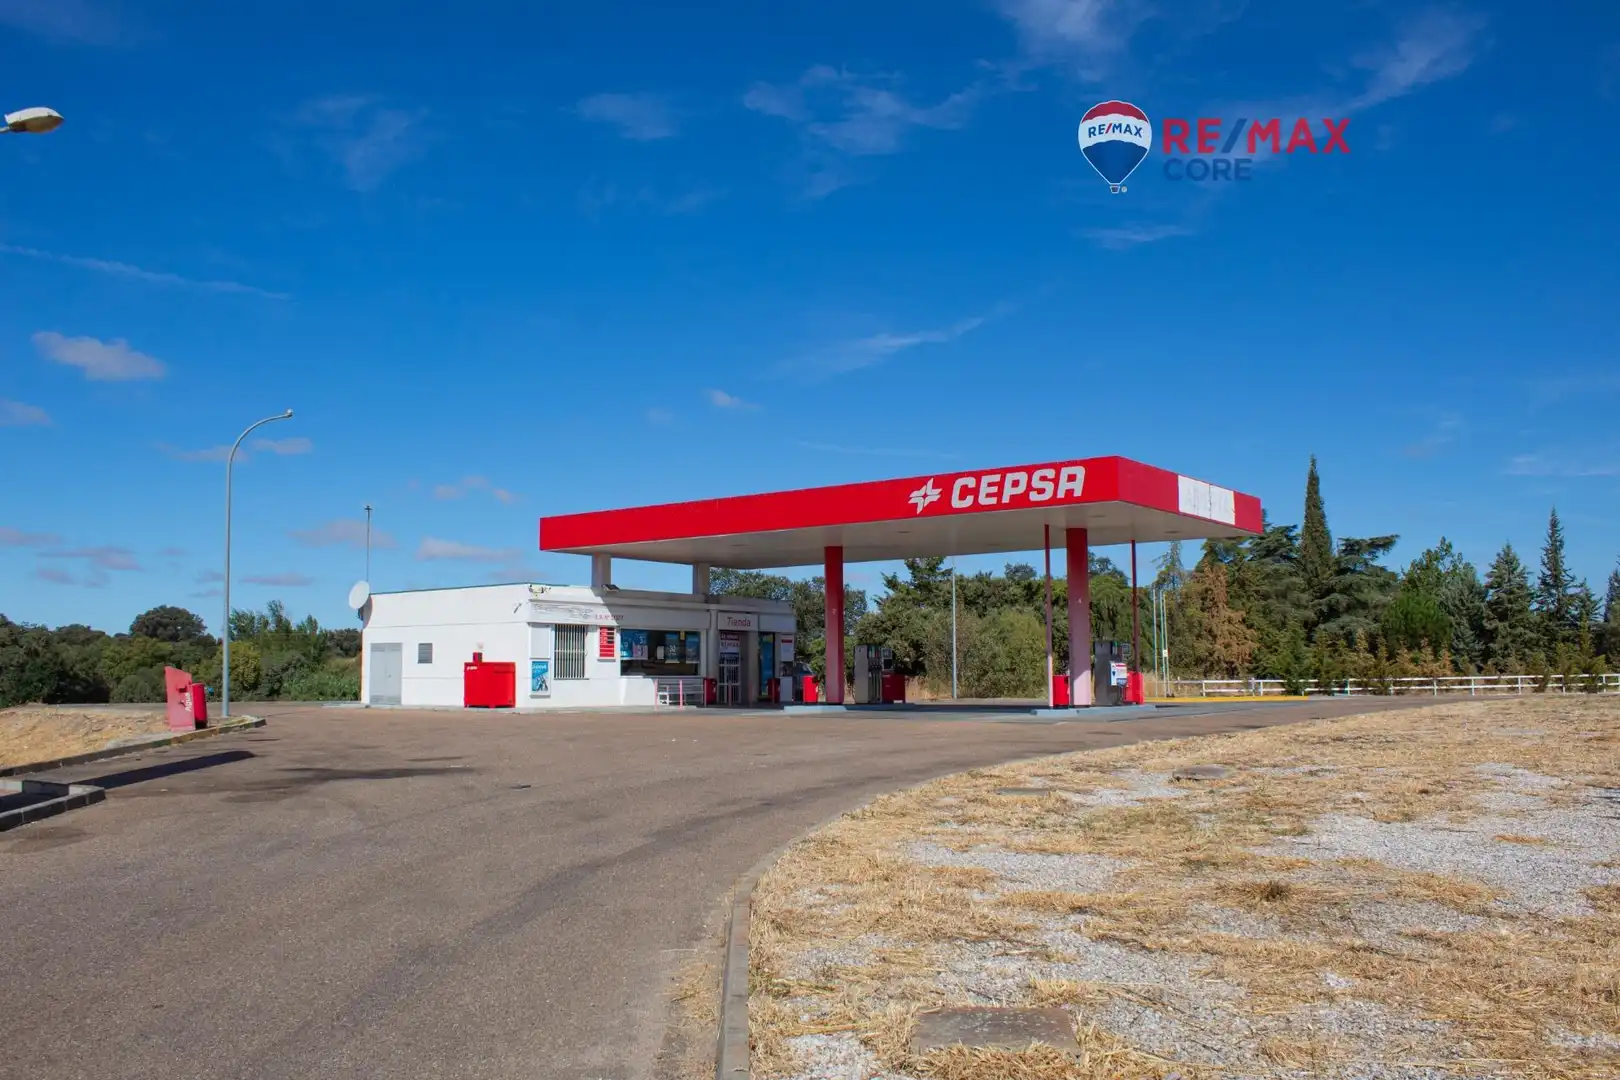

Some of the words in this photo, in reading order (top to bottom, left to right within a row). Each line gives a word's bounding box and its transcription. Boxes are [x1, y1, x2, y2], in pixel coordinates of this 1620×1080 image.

[951, 466, 1086, 509] CEPSA
[727, 616, 751, 627] Tienda
[184, 692, 193, 712] Agua
